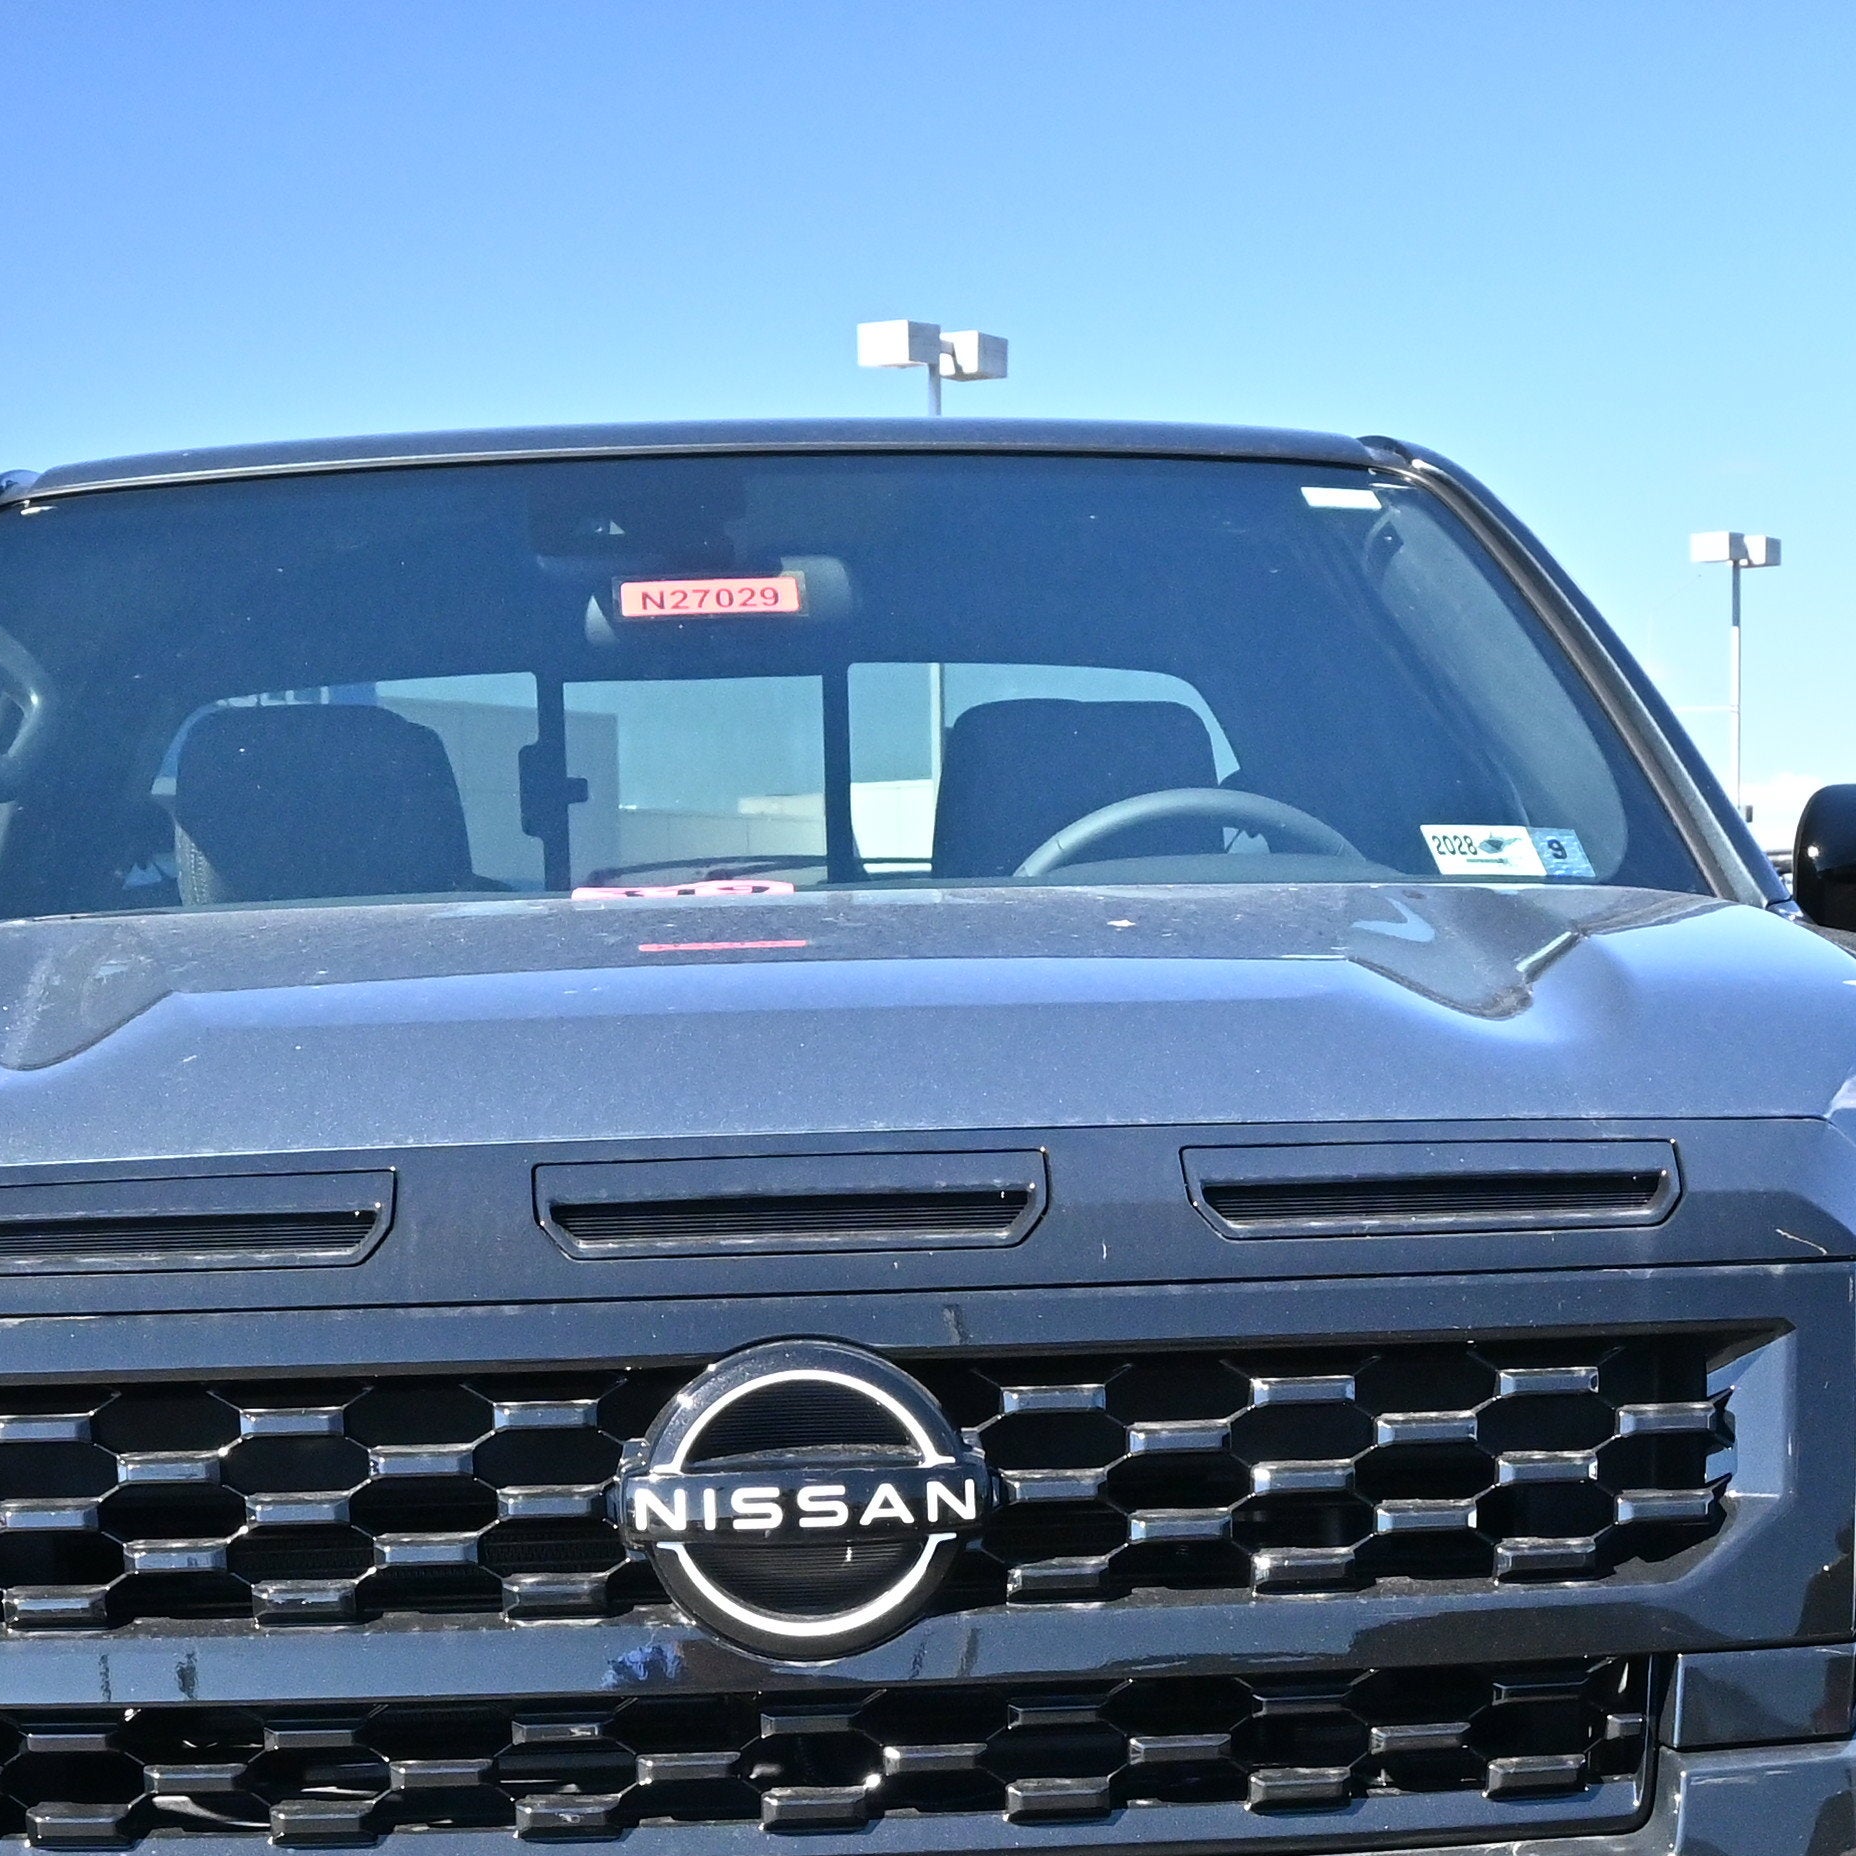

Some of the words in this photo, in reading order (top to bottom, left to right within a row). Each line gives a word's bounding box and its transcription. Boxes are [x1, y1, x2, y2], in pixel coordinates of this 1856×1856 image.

[641, 586, 780, 611] N27029
[1431, 834, 1478, 856] 2028
[1547, 838, 1568, 860] 9
[633, 1478, 977, 1532] NISSAN
